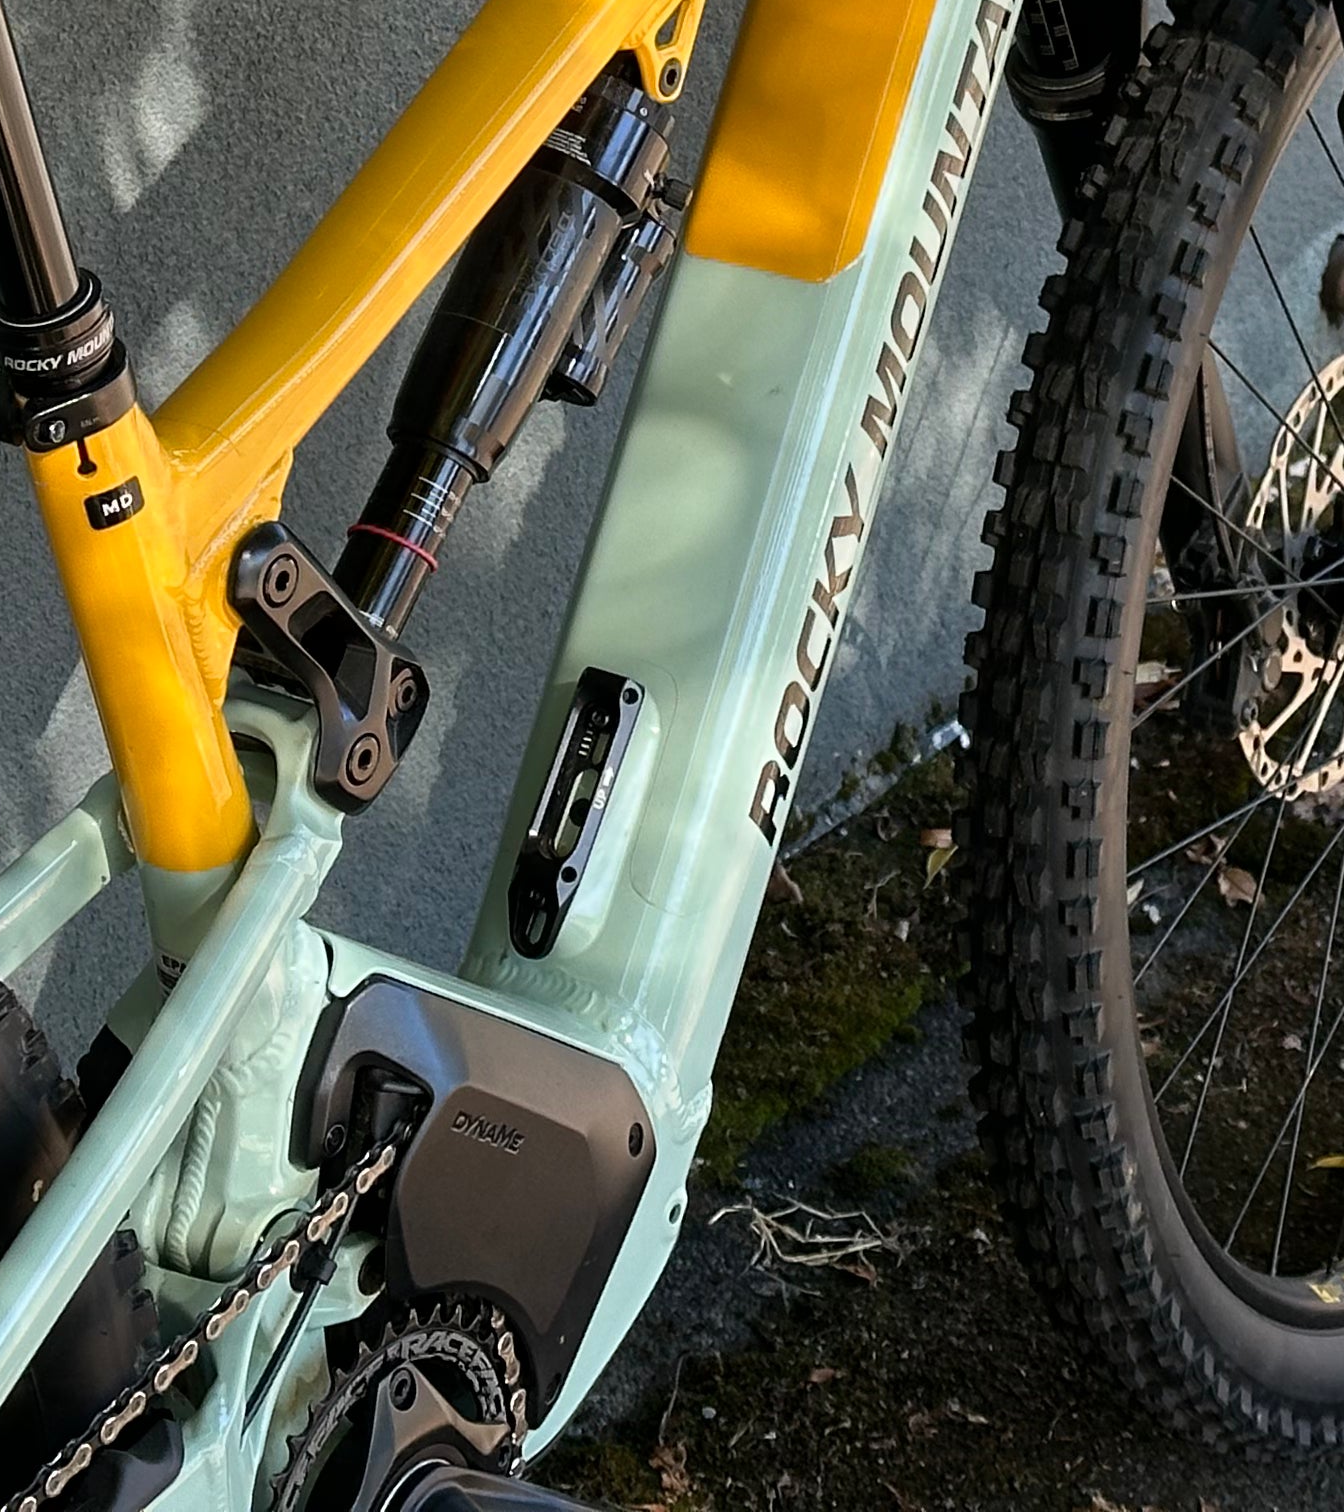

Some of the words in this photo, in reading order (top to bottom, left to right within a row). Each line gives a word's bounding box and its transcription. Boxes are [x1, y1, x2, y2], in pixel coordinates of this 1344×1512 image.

[4, 354, 64, 372] ROCKY
[102, 494, 133, 517] MD
[749, 463, 864, 846] ROCKY
[593, 788, 607, 810] UP
[449, 1108, 526, 1156] DYNAME
